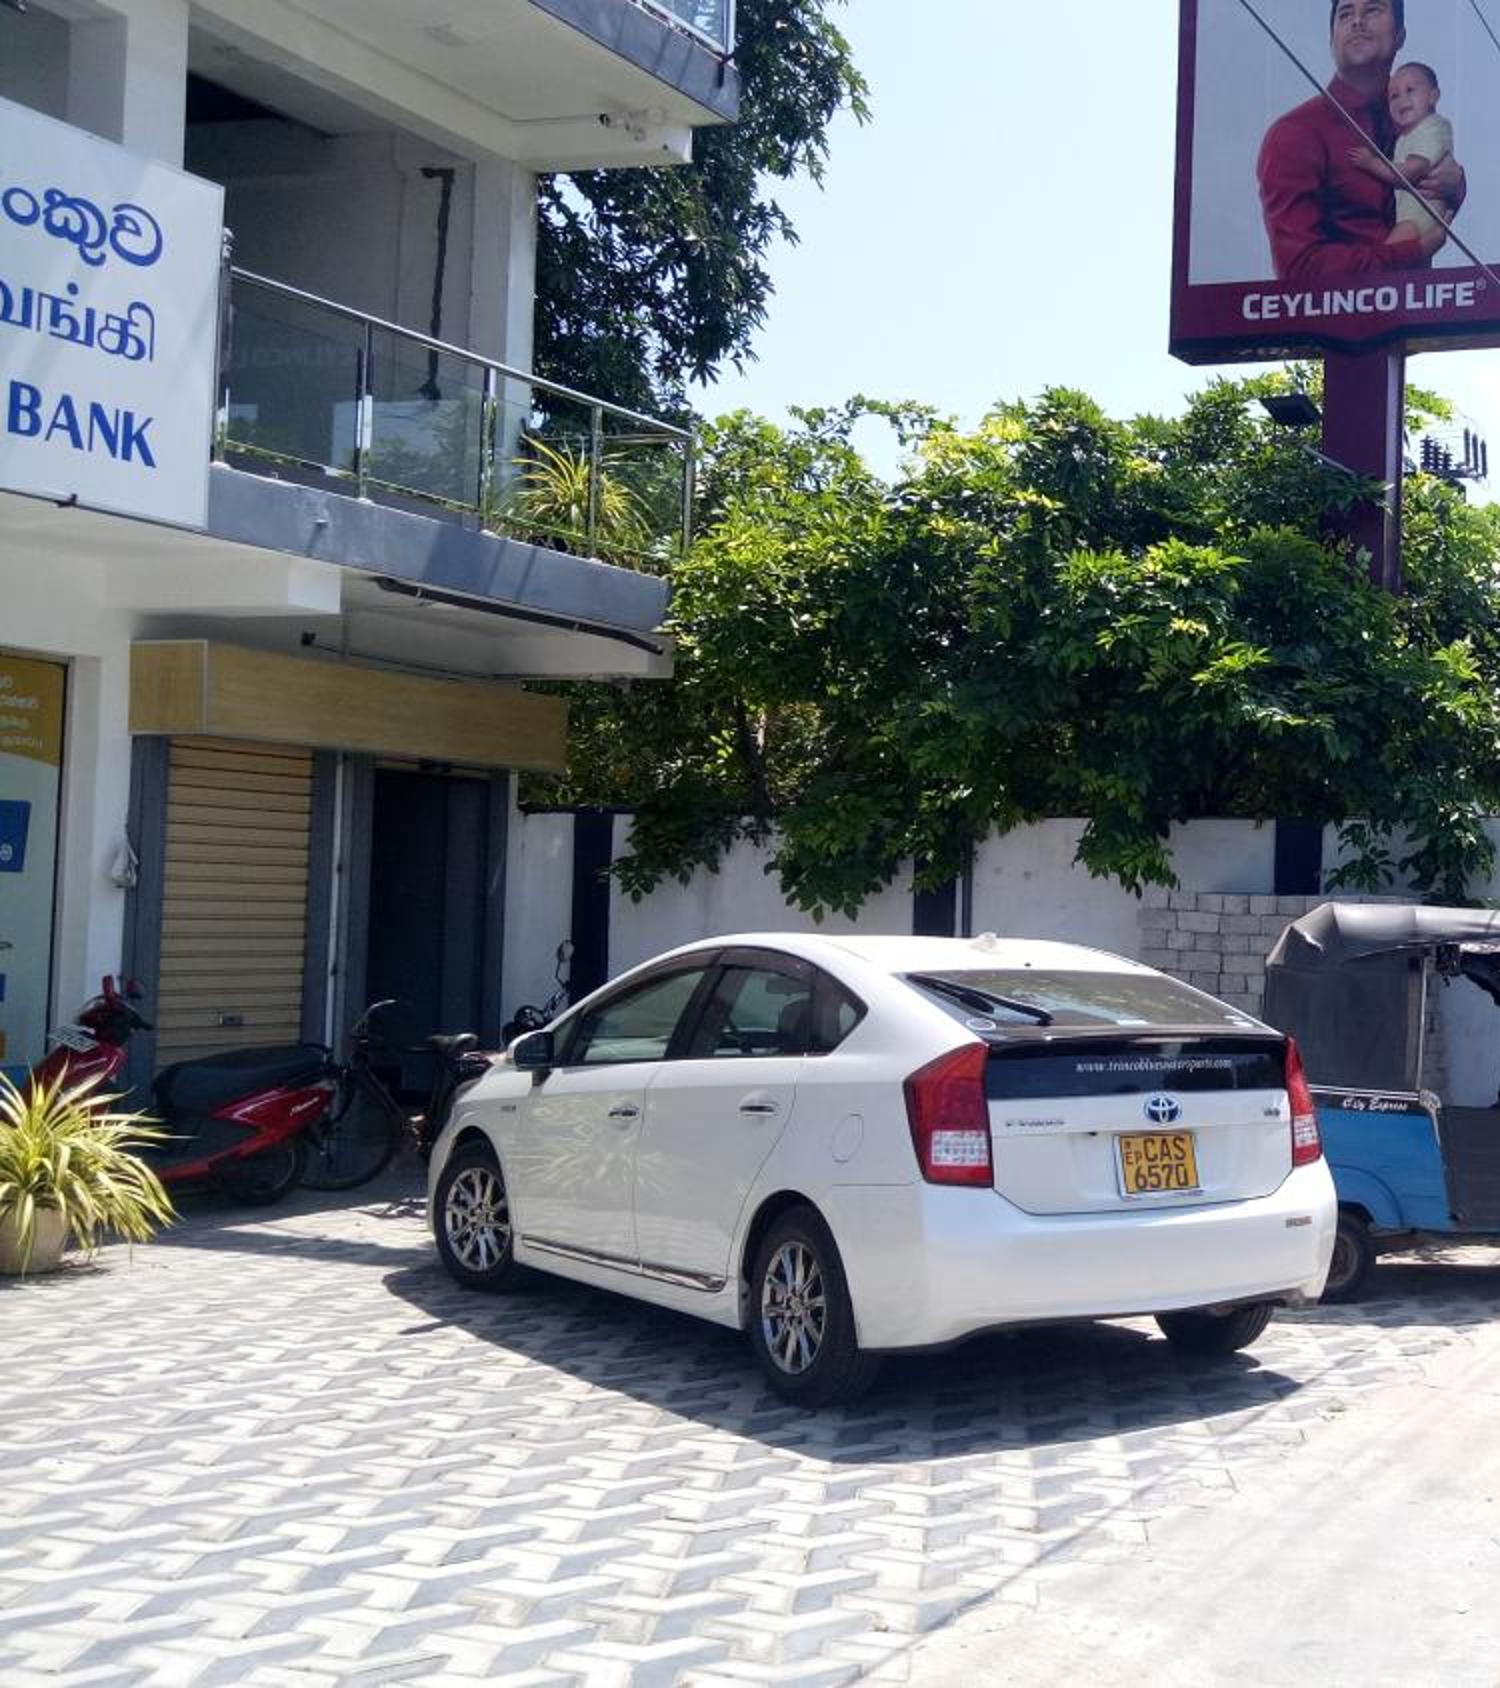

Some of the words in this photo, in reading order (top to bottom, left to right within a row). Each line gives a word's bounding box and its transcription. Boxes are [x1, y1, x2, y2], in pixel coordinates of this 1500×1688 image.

[2, 187, 163, 267] ංකුව
[1242, 286, 1398, 321] CEYLINCO
[7, 379, 157, 468] BANK
[1143, 1135, 1187, 1162] CAS
[1135, 1162, 1189, 1190] 6570
